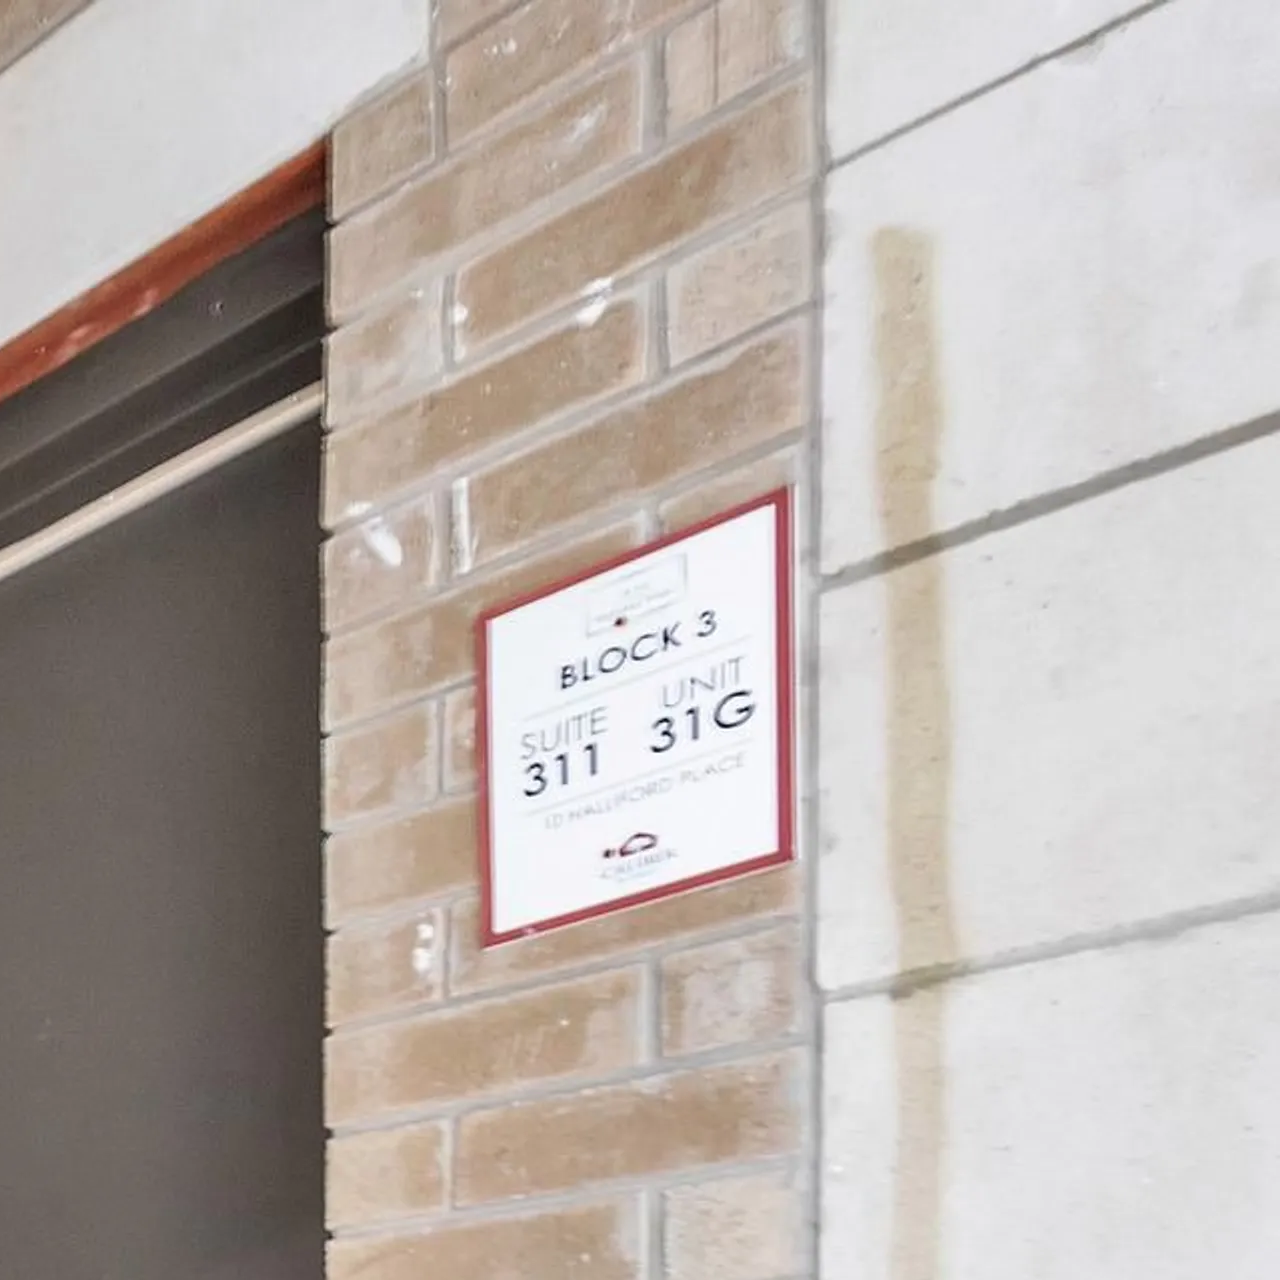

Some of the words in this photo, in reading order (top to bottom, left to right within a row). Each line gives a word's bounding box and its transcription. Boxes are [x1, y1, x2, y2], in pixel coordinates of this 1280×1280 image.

[560, 621, 682, 689] BLOCK
[696, 609, 718, 638] 3
[662, 656, 747, 707] UNIT
[520, 705, 609, 760] SUITE
[649, 689, 757, 753] 31G
[523, 742, 599, 798] 311
[679, 751, 748, 783] PLACE
